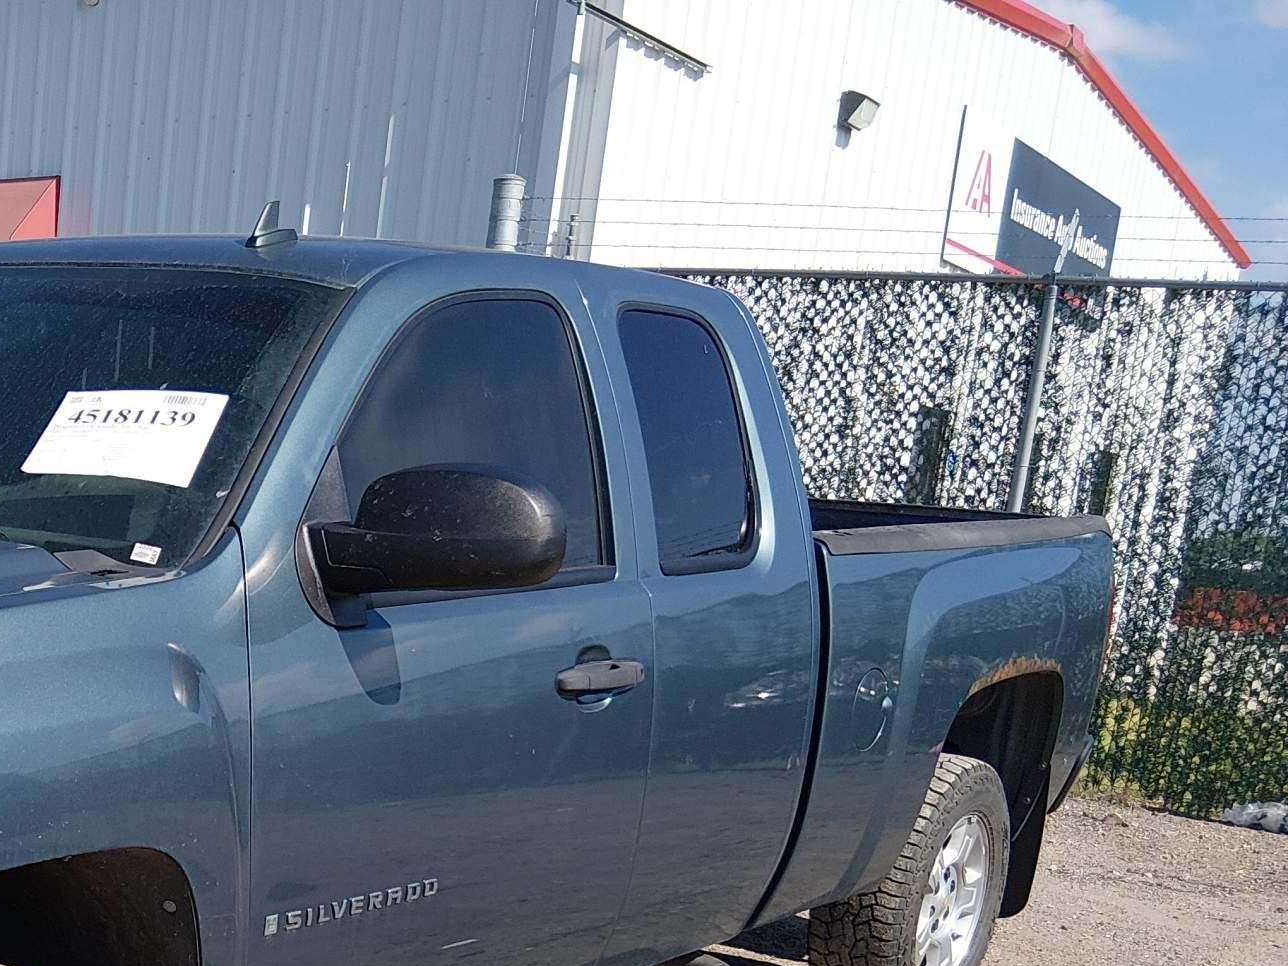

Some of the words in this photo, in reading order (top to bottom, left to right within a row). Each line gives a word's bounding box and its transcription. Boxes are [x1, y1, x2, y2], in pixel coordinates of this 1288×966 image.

[1010, 188, 1056, 240] Insurance
[1073, 225, 1108, 269] Auctions
[68, 408, 196, 427] 45181139
[285, 878, 439, 931] SILVERADO
